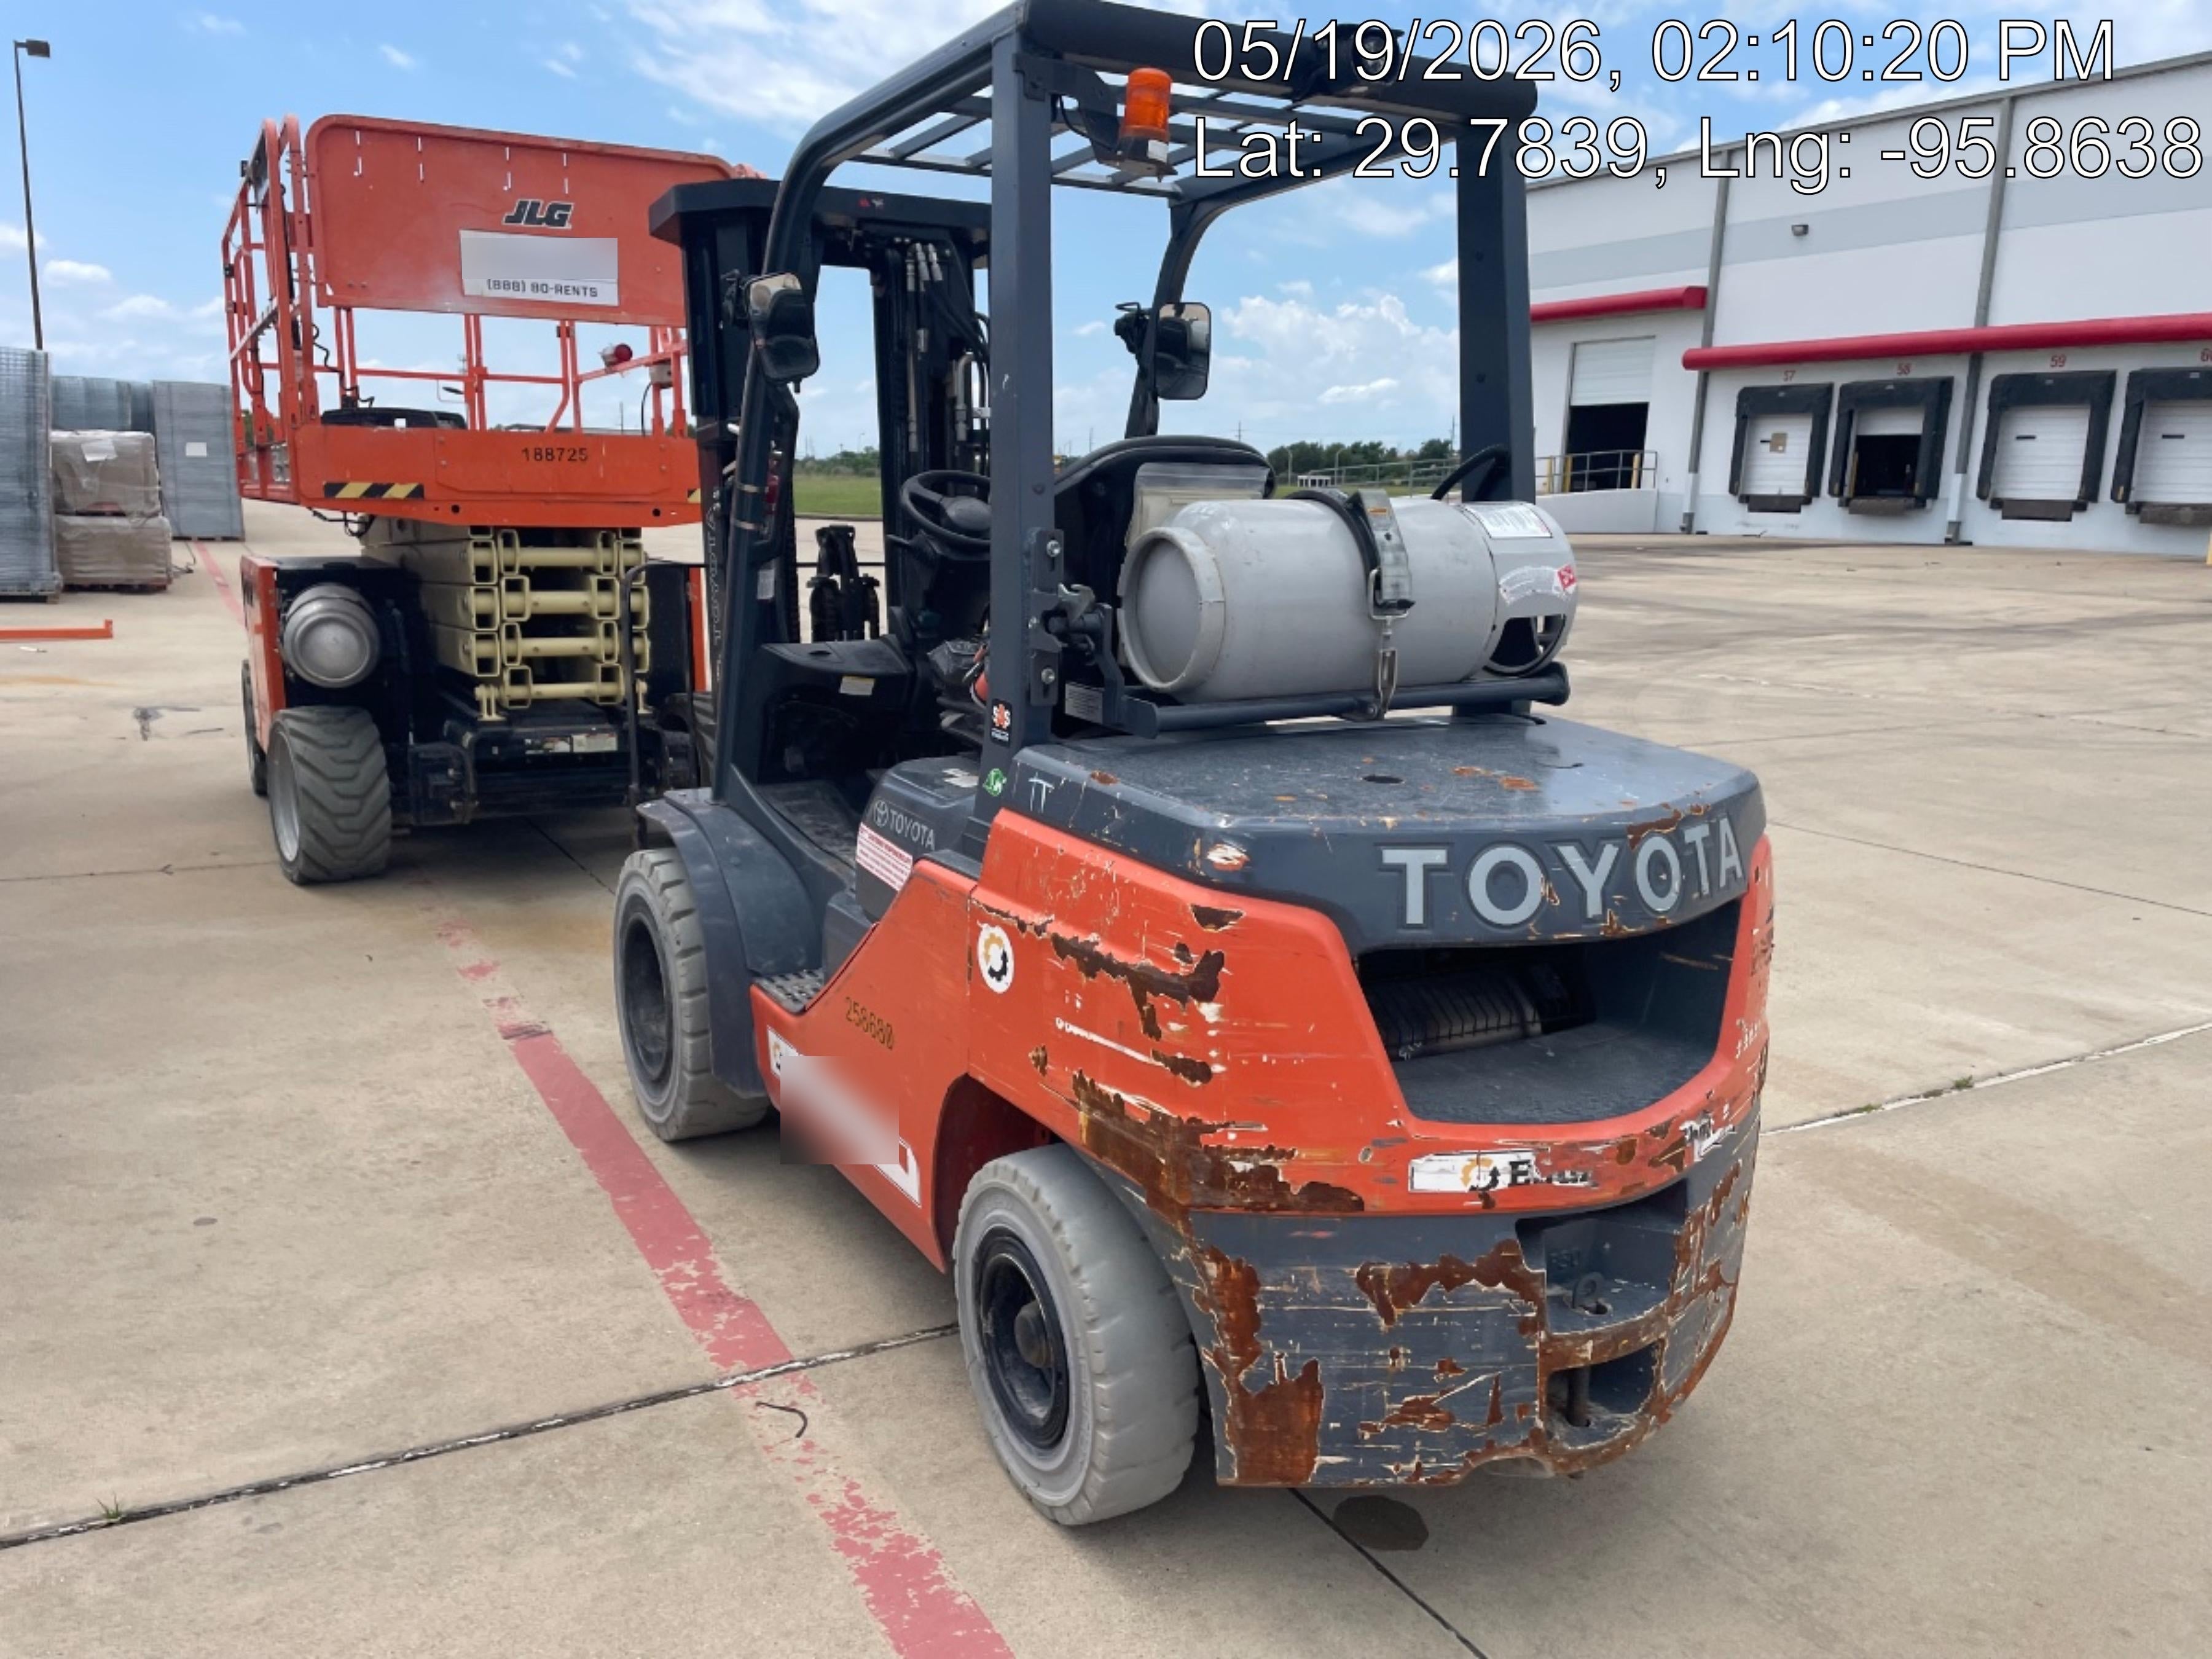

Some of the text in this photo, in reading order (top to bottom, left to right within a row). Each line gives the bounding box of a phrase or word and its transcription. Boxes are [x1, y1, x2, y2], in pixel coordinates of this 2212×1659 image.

[503, 200, 574, 229] JLG
[487, 278, 526, 292] (888)
[521, 447, 589, 461] 188725
[890, 809, 935, 852] TOYOTA
[1381, 817, 1743, 925] TOYOTA
